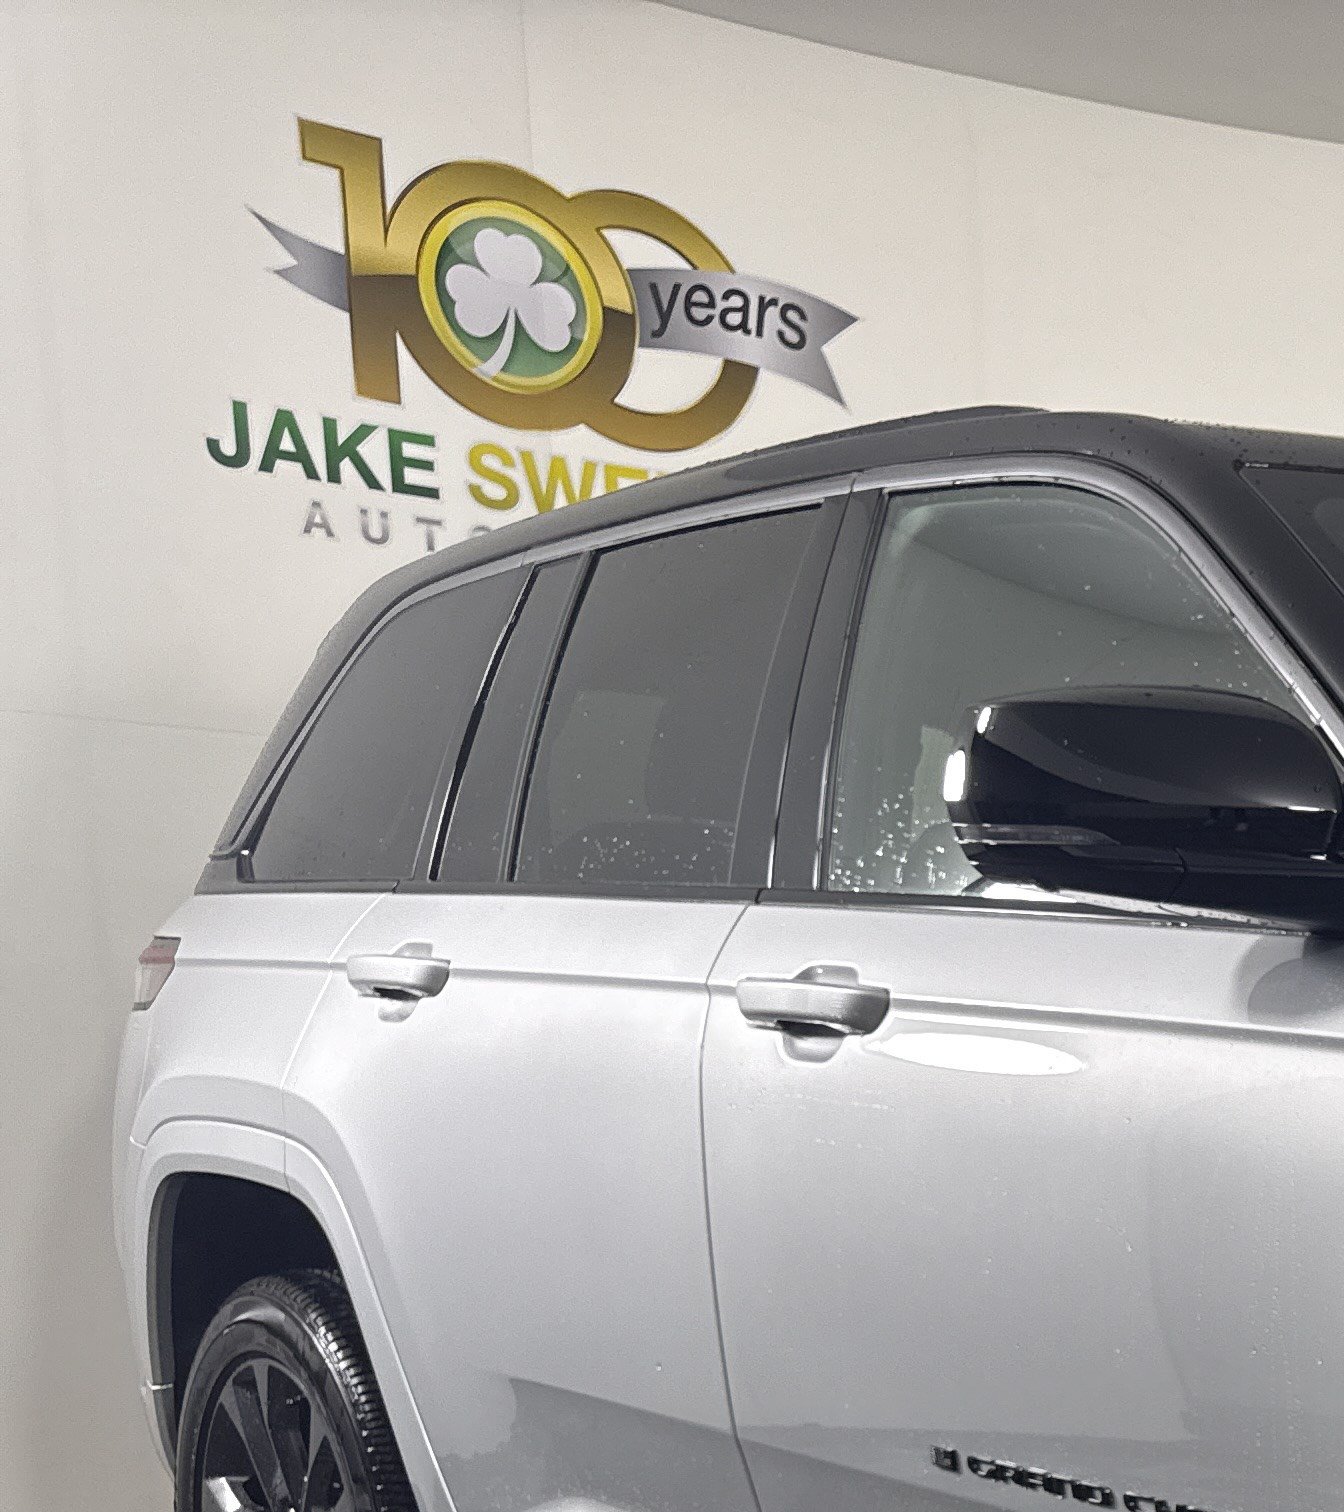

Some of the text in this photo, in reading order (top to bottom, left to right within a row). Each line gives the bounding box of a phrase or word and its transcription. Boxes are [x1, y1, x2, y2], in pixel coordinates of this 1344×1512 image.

[297, 116, 808, 453] 100 years
[206, 398, 668, 515] JAKE SW
[302, 500, 492, 554] AUT
[967, 1455, 1116, 1510] GRAND
